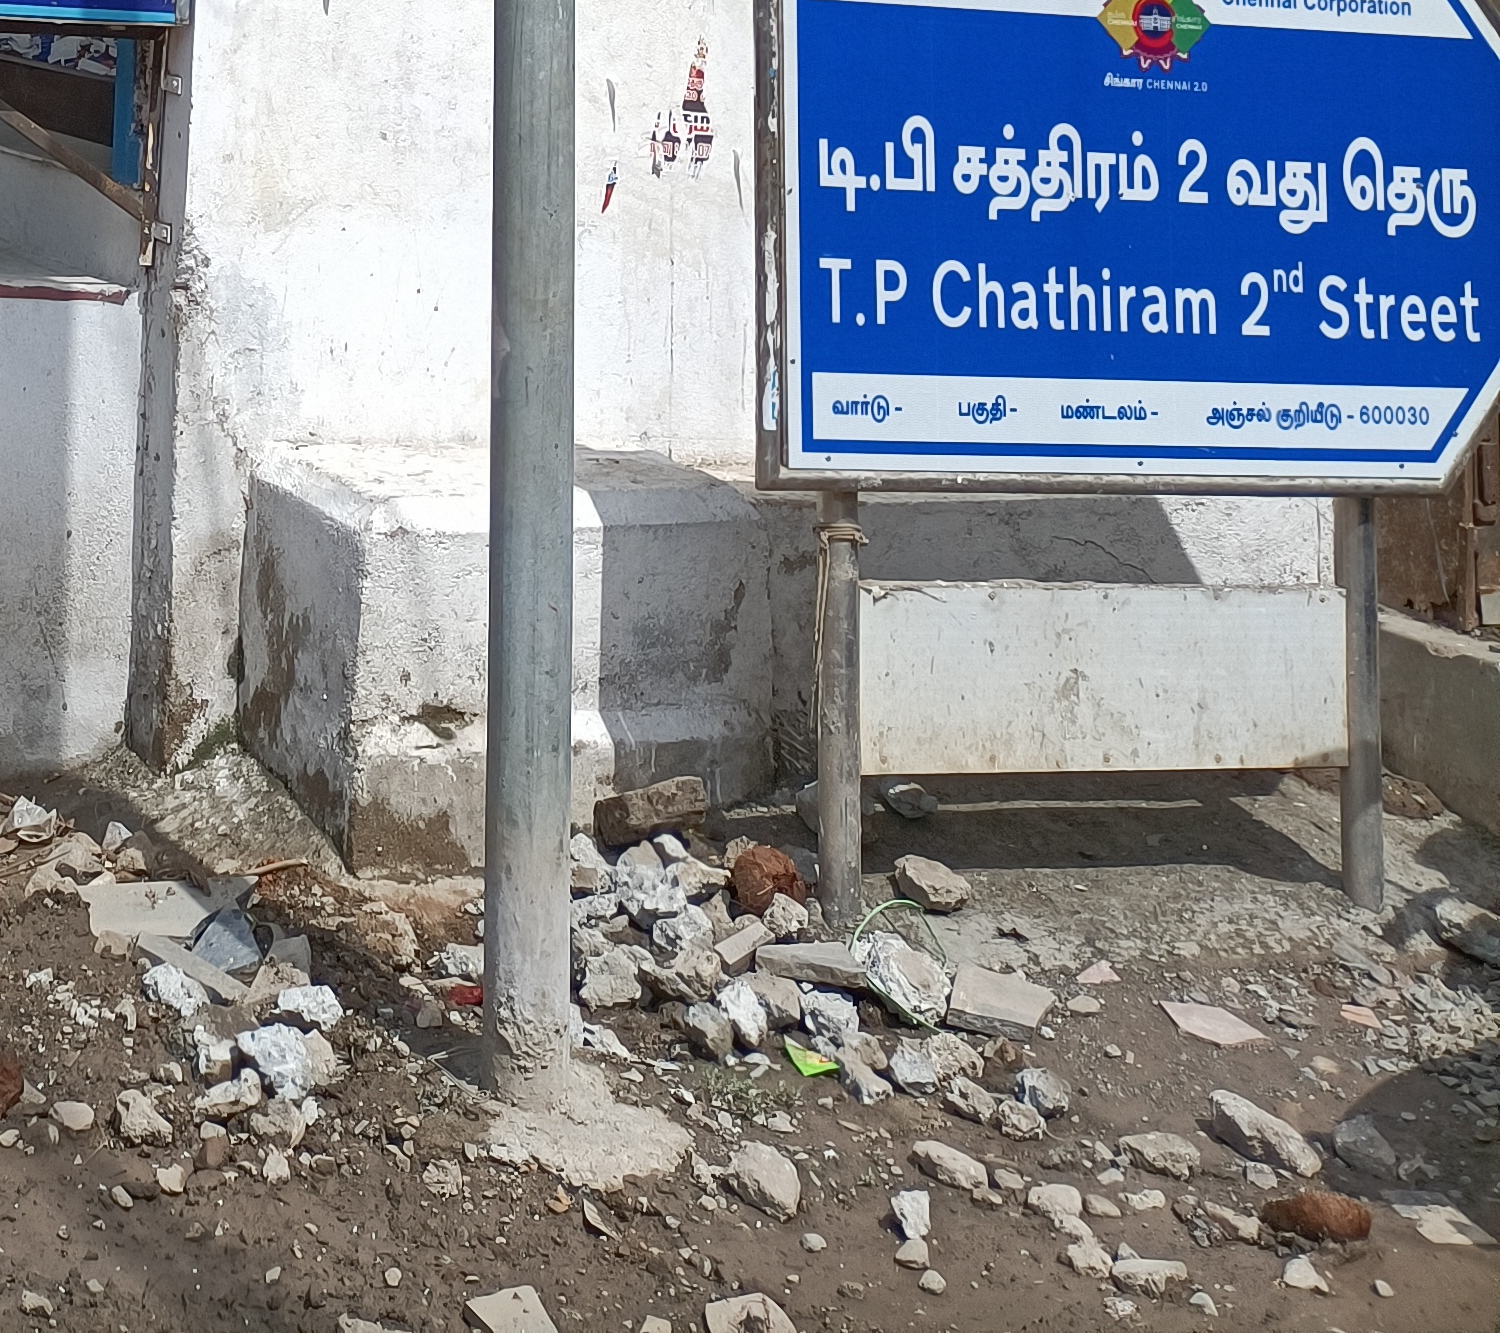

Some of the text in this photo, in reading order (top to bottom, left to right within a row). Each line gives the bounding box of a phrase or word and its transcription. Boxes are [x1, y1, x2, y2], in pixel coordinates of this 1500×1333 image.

[1146, 79, 1191, 91] CHENNAI
[1193, 82, 1208, 92] 2.0
[818, 115, 937, 211] டி.பி
[952, 122, 1159, 223] சத்திரம்
[1177, 138, 1209, 204] 2
[1225, 159, 1328, 235] வது
[1341, 136, 1477, 239] தெரு
[819, 257, 1481, 343] T.P Chathiram 2nd Street
[1206, 400, 1272, 429] அஞ்சல்
[1276, 401, 1342, 430] குறியீடு
[1359, 405, 1430, 425] 600030
